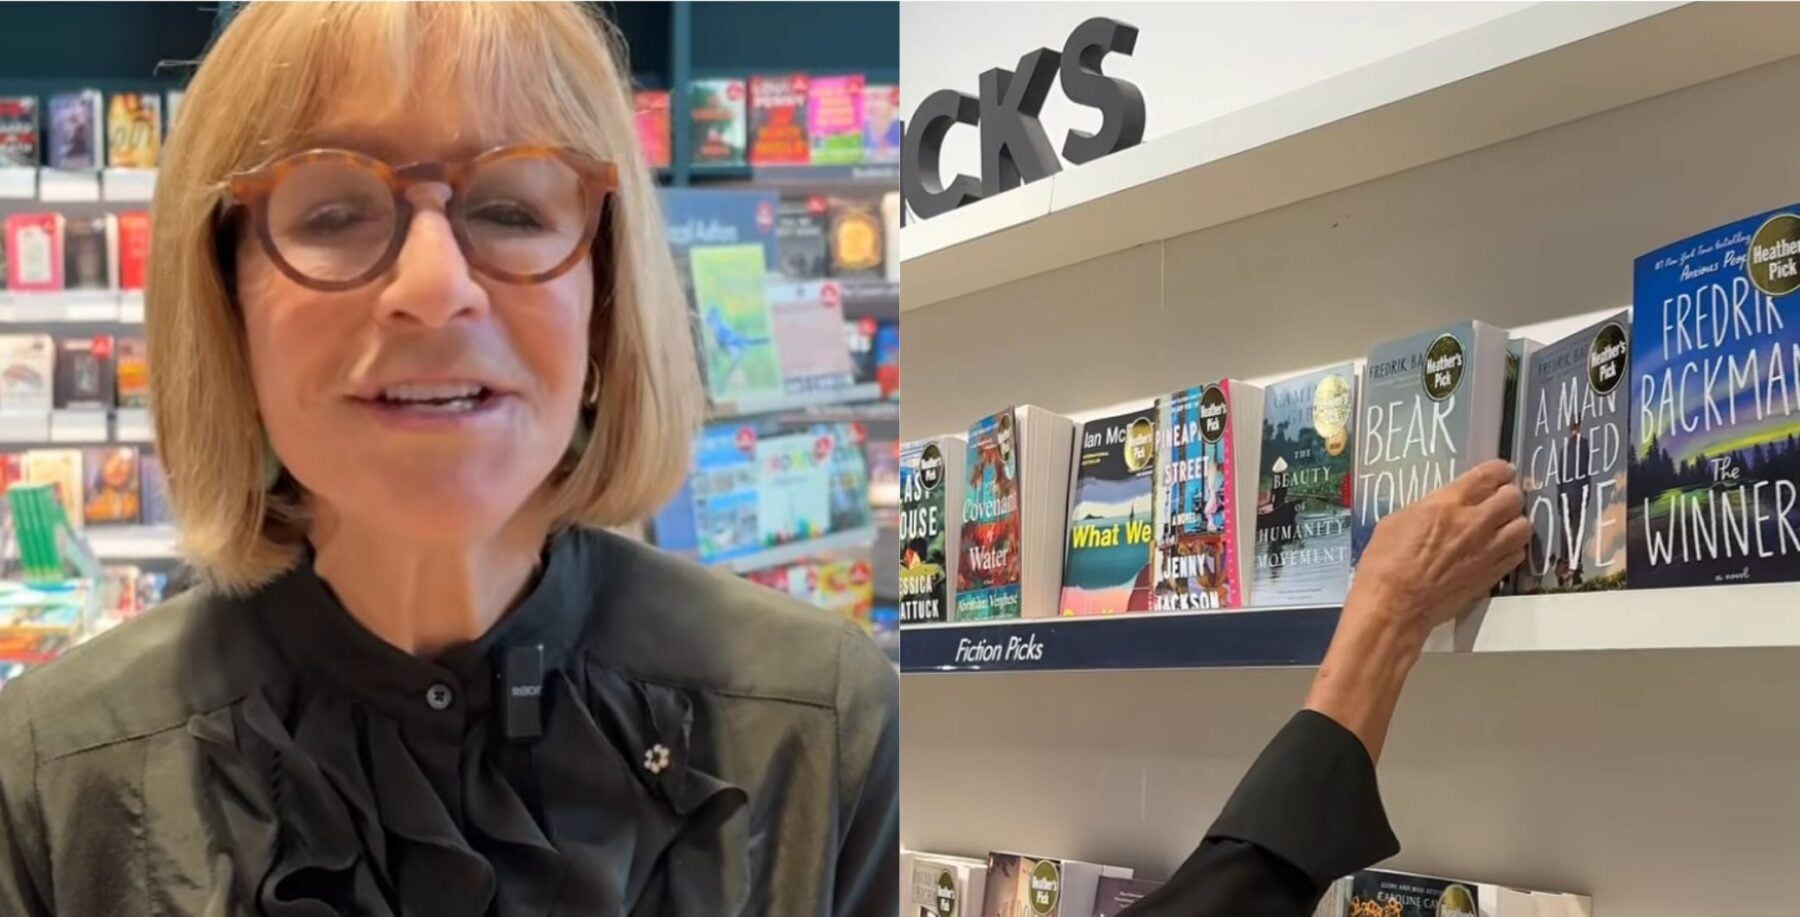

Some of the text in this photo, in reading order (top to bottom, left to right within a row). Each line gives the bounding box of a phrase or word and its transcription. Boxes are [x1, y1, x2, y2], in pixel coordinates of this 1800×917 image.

[900, 17, 1146, 228] CKS
[1680, 250, 1748, 282] Anxious Peop
[1769, 258, 1797, 281] Pick
[1663, 276, 1784, 361] FREDRIK
[1426, 353, 1462, 374] Heather's
[1591, 341, 1626, 368] Heather's
[1370, 356, 1407, 379] FREDRIK
[1600, 362, 1617, 383] Pick
[1434, 372, 1450, 388] Pick
[1201, 402, 1226, 418] Heather's
[1535, 388, 1549, 437] A
[1206, 418, 1220, 433] Pick
[1364, 394, 1457, 466] BEAR
[1084, 431, 1101, 449] Ian
[1294, 449, 1311, 460] THE
[1531, 422, 1620, 490] CALLED
[1165, 456, 1209, 485] STREET
[1274, 465, 1333, 489] BEAUTY
[1711, 457, 1740, 481] The
[1072, 520, 1151, 548] What We
[1258, 519, 1345, 544] HUMANITY
[1528, 479, 1617, 577] OVE
[969, 546, 1008, 571] Water
[1163, 554, 1207, 579] JENNY
[1256, 546, 1347, 570] MOVEMENT
[1725, 567, 1750, 582] novel
[900, 598, 939, 620] ATTUCK
[1155, 591, 1219, 611] JACKSON
[955, 632, 1044, 663] Fiction Picks
[1377, 891, 1421, 907] CAROLINE
